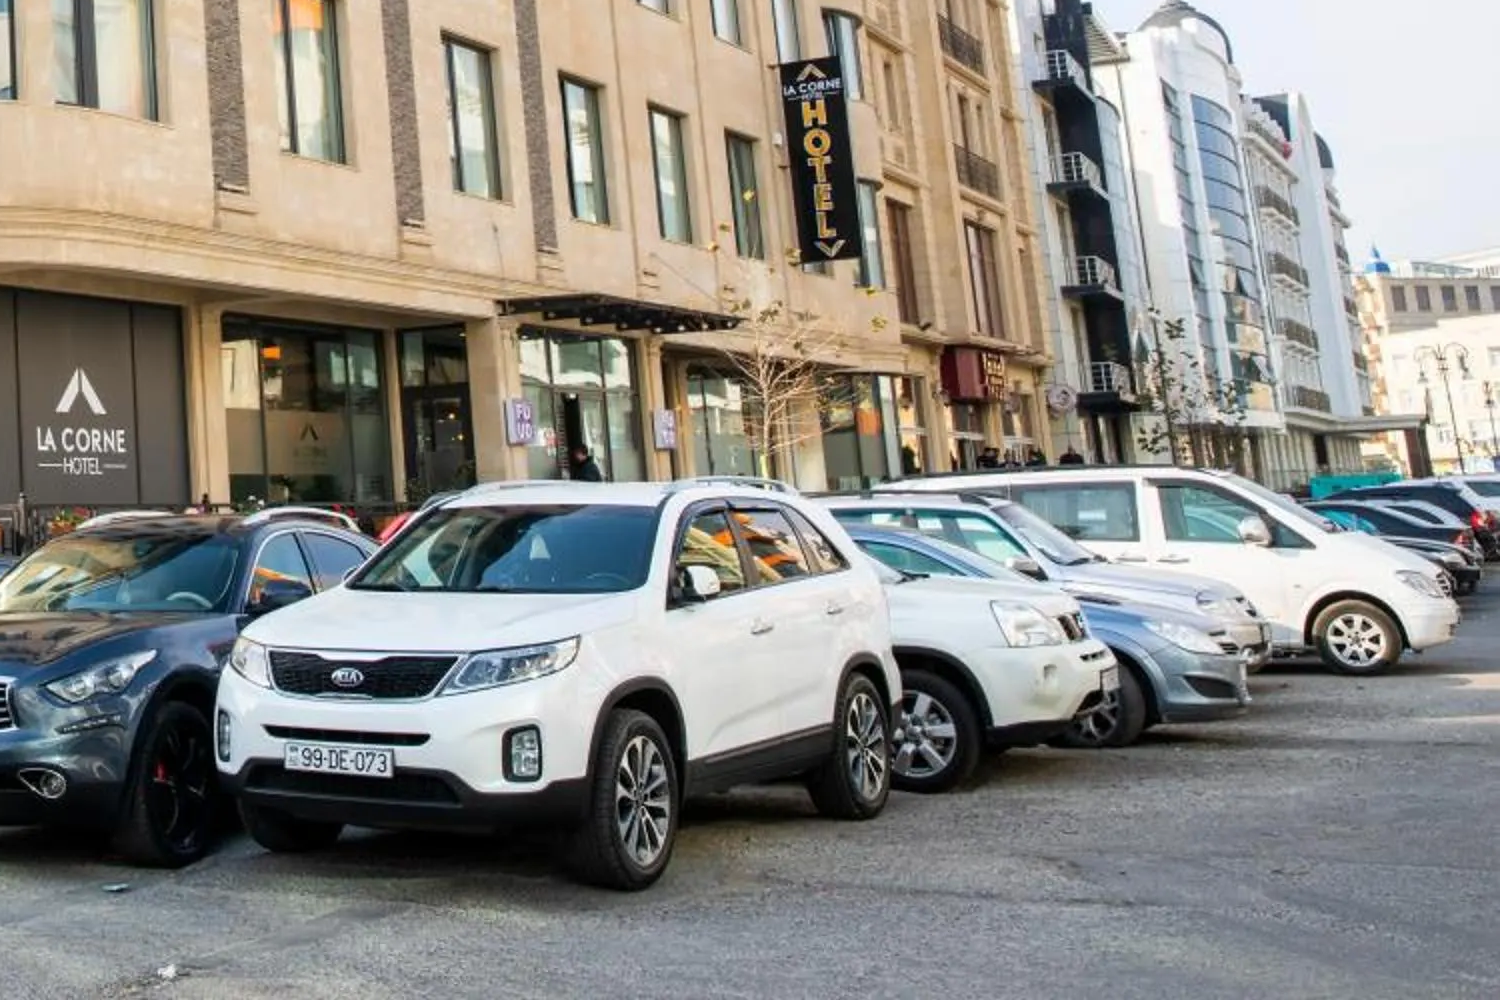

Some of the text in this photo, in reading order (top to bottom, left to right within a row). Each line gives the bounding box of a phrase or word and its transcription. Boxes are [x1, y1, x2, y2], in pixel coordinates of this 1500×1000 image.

[802, 99, 838, 238] HOTEL
[37, 426, 127, 453] LA CORNE
[63, 457, 103, 475] HOTEL
[301, 747, 388, 773] 99-DE-073
